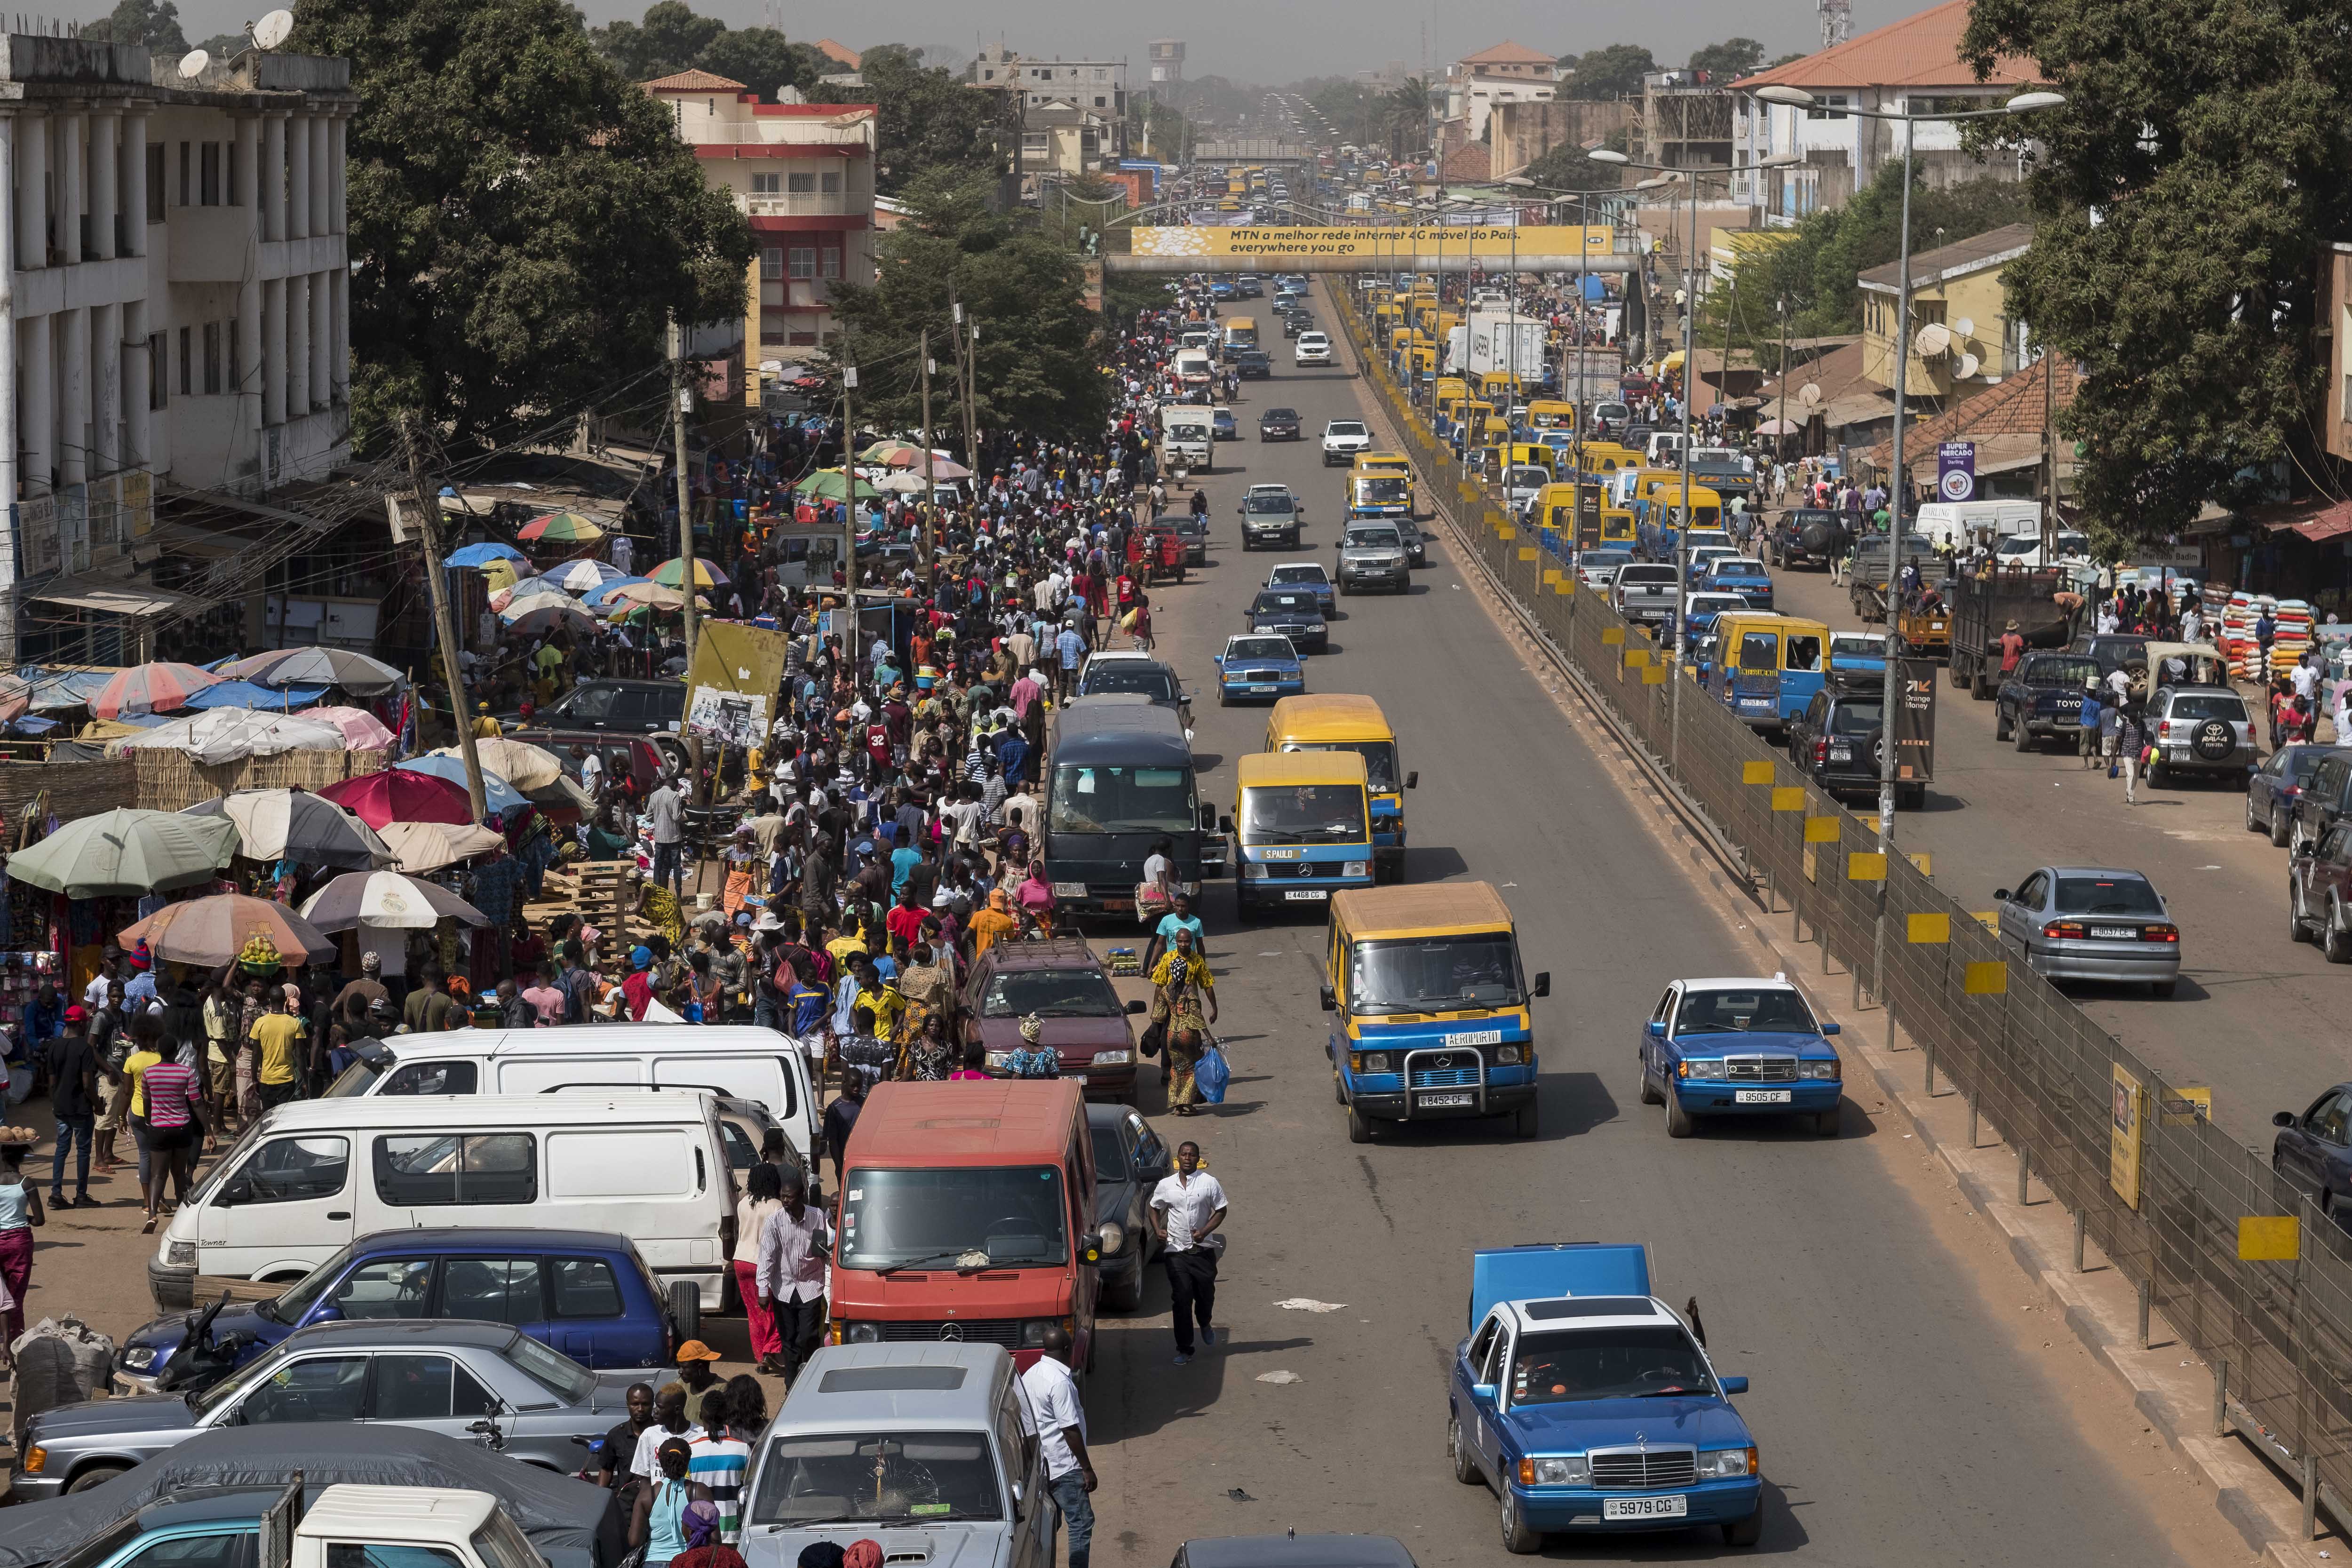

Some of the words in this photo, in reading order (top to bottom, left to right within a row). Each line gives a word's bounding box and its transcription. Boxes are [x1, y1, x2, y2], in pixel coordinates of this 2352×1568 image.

[1231, 230, 1259, 240] MTN
[1273, 230, 1319, 240] melhor
[1321, 230, 1351, 240] rede
[1354, 230, 1406, 240] internet
[1408, 230, 1425, 240] 4G
[1429, 229, 1468, 240] móvel
[1471, 230, 1486, 240] do
[1230, 242, 1308, 254] everywhere
[1311, 245, 1335, 255] you
[1337, 244, 1355, 255] go
[1923, 507, 1950, 517] DARLING
[1905, 695, 1931, 703] Orange
[871, 734, 884, 747] 32
[1266, 850, 1292, 859] S.PAULO
[1449, 1032, 1498, 1045] AEROPORTO
